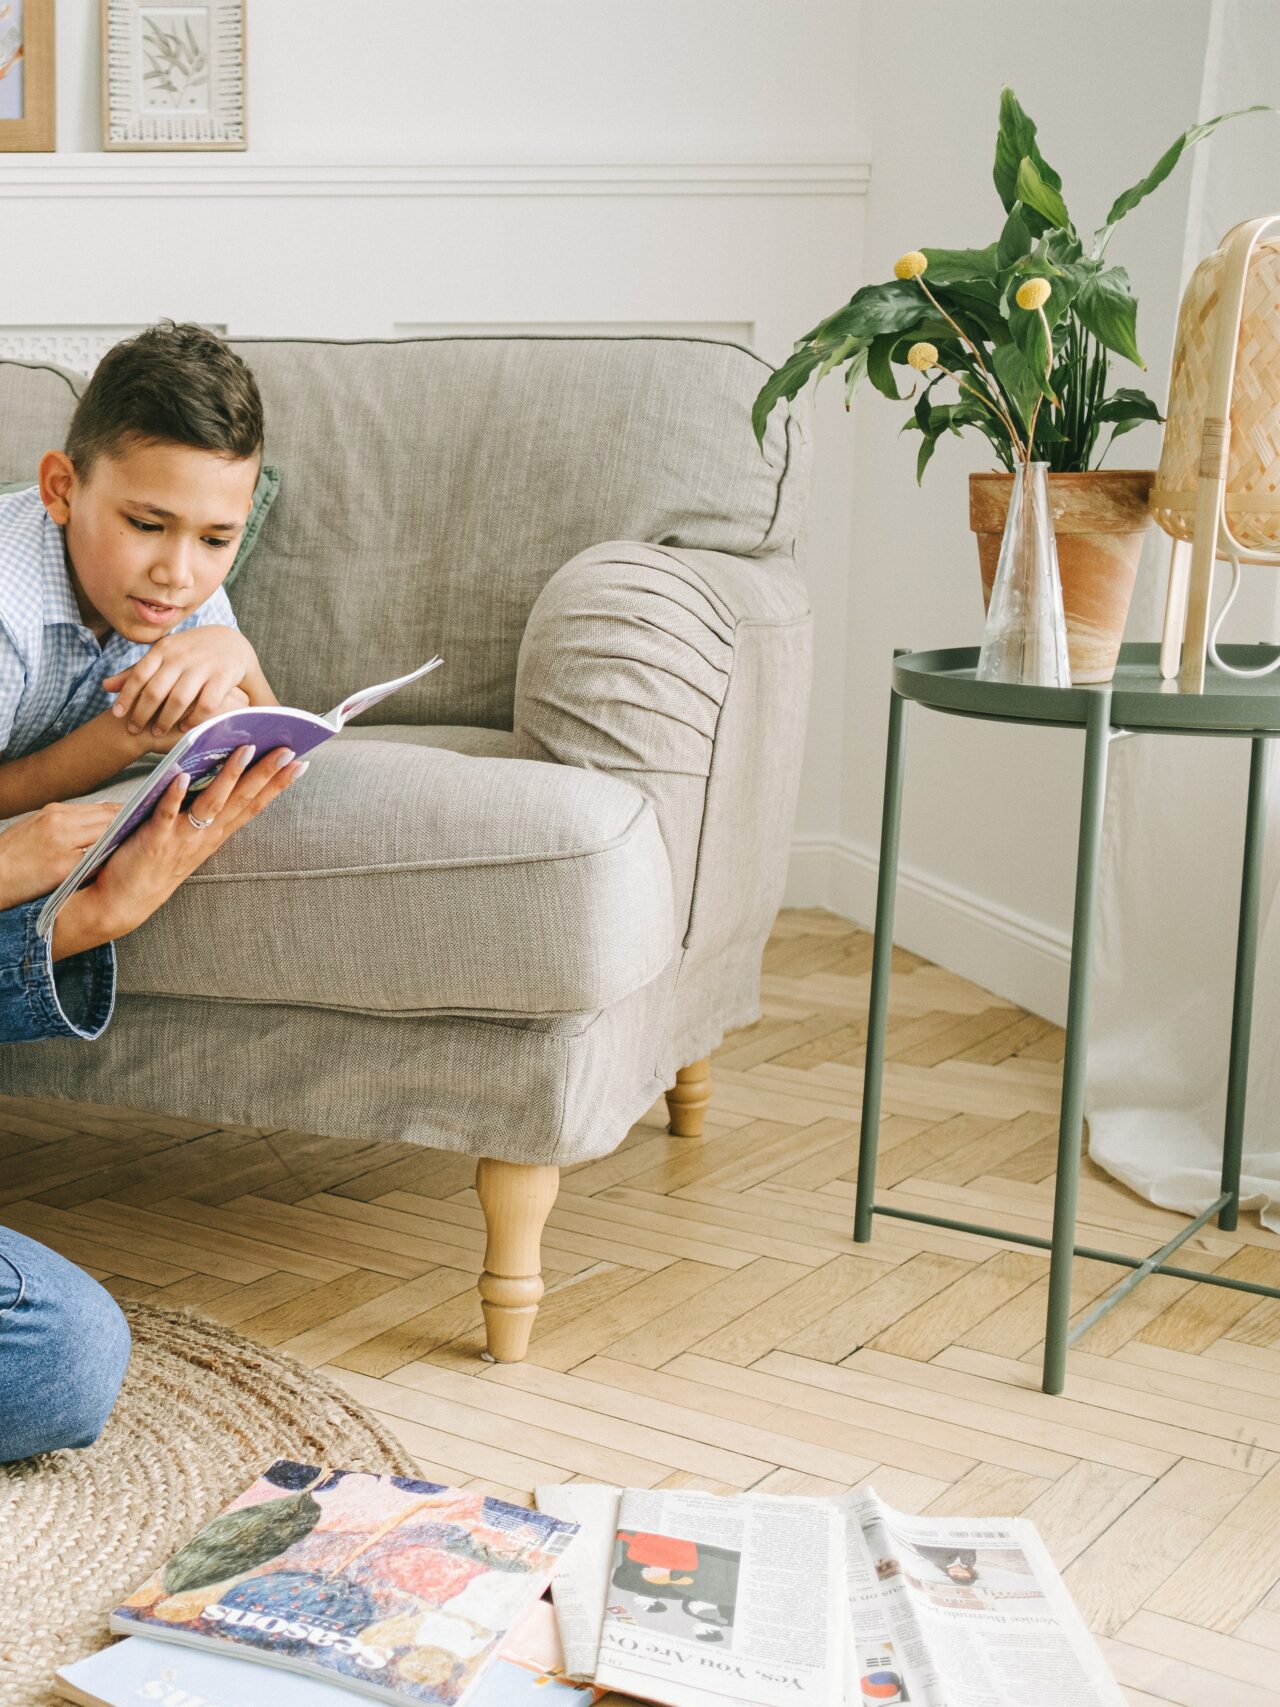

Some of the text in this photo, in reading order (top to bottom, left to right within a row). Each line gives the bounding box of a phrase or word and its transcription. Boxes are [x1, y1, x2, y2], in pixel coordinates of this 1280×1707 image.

[1009, 1614, 1061, 1626] Venice
[200, 1604, 394, 1669] Seasons
[646, 1645, 692, 1663] Are
[700, 1657, 747, 1679] You
[755, 1669, 805, 1690] Yes,
